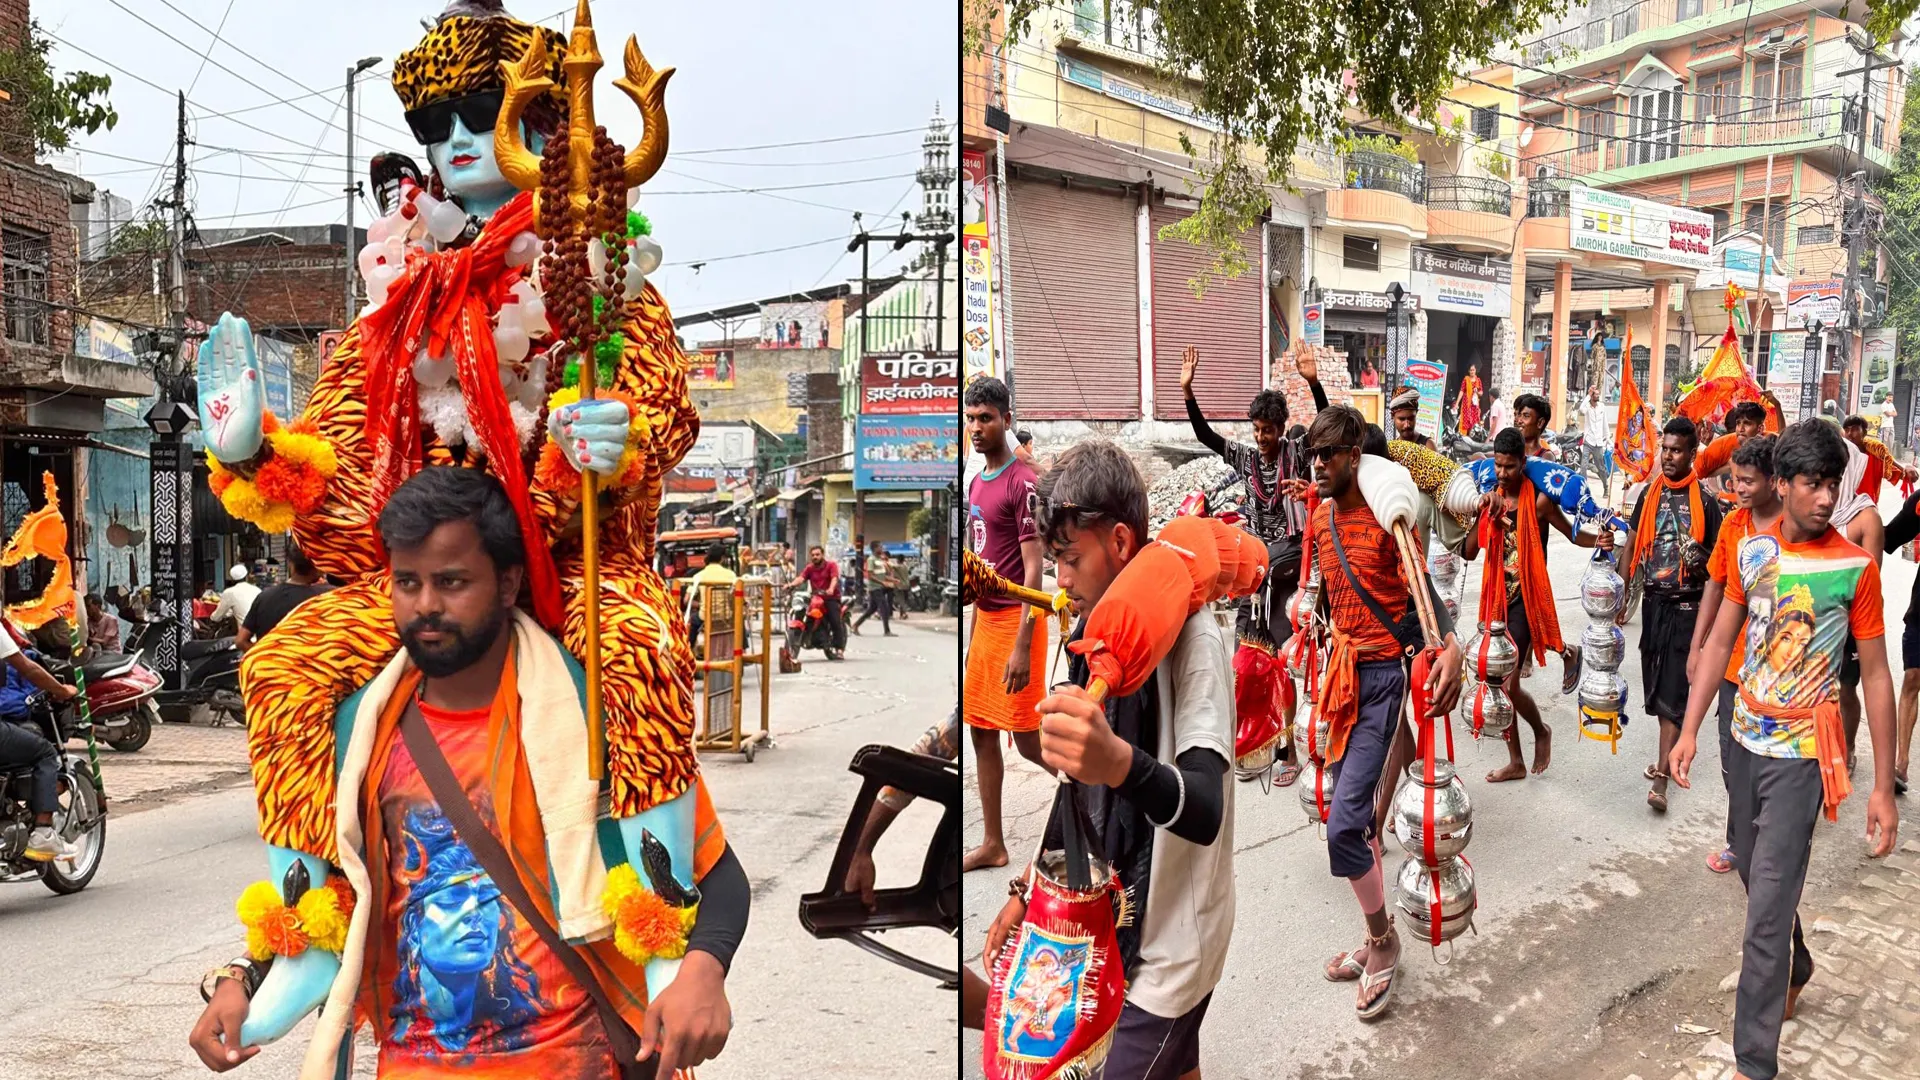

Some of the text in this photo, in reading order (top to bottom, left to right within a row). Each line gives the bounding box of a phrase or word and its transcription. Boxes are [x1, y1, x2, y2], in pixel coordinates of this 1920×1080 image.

[1575, 236, 1649, 259] AMROHA GARMENTS
[964, 277, 988, 294] Tamil
[967, 293, 987, 308] Nadu
[1355, 291, 1392, 309] मेडिकल
[966, 309, 988, 323] Dosa
[876, 352, 958, 379] पवित्र
